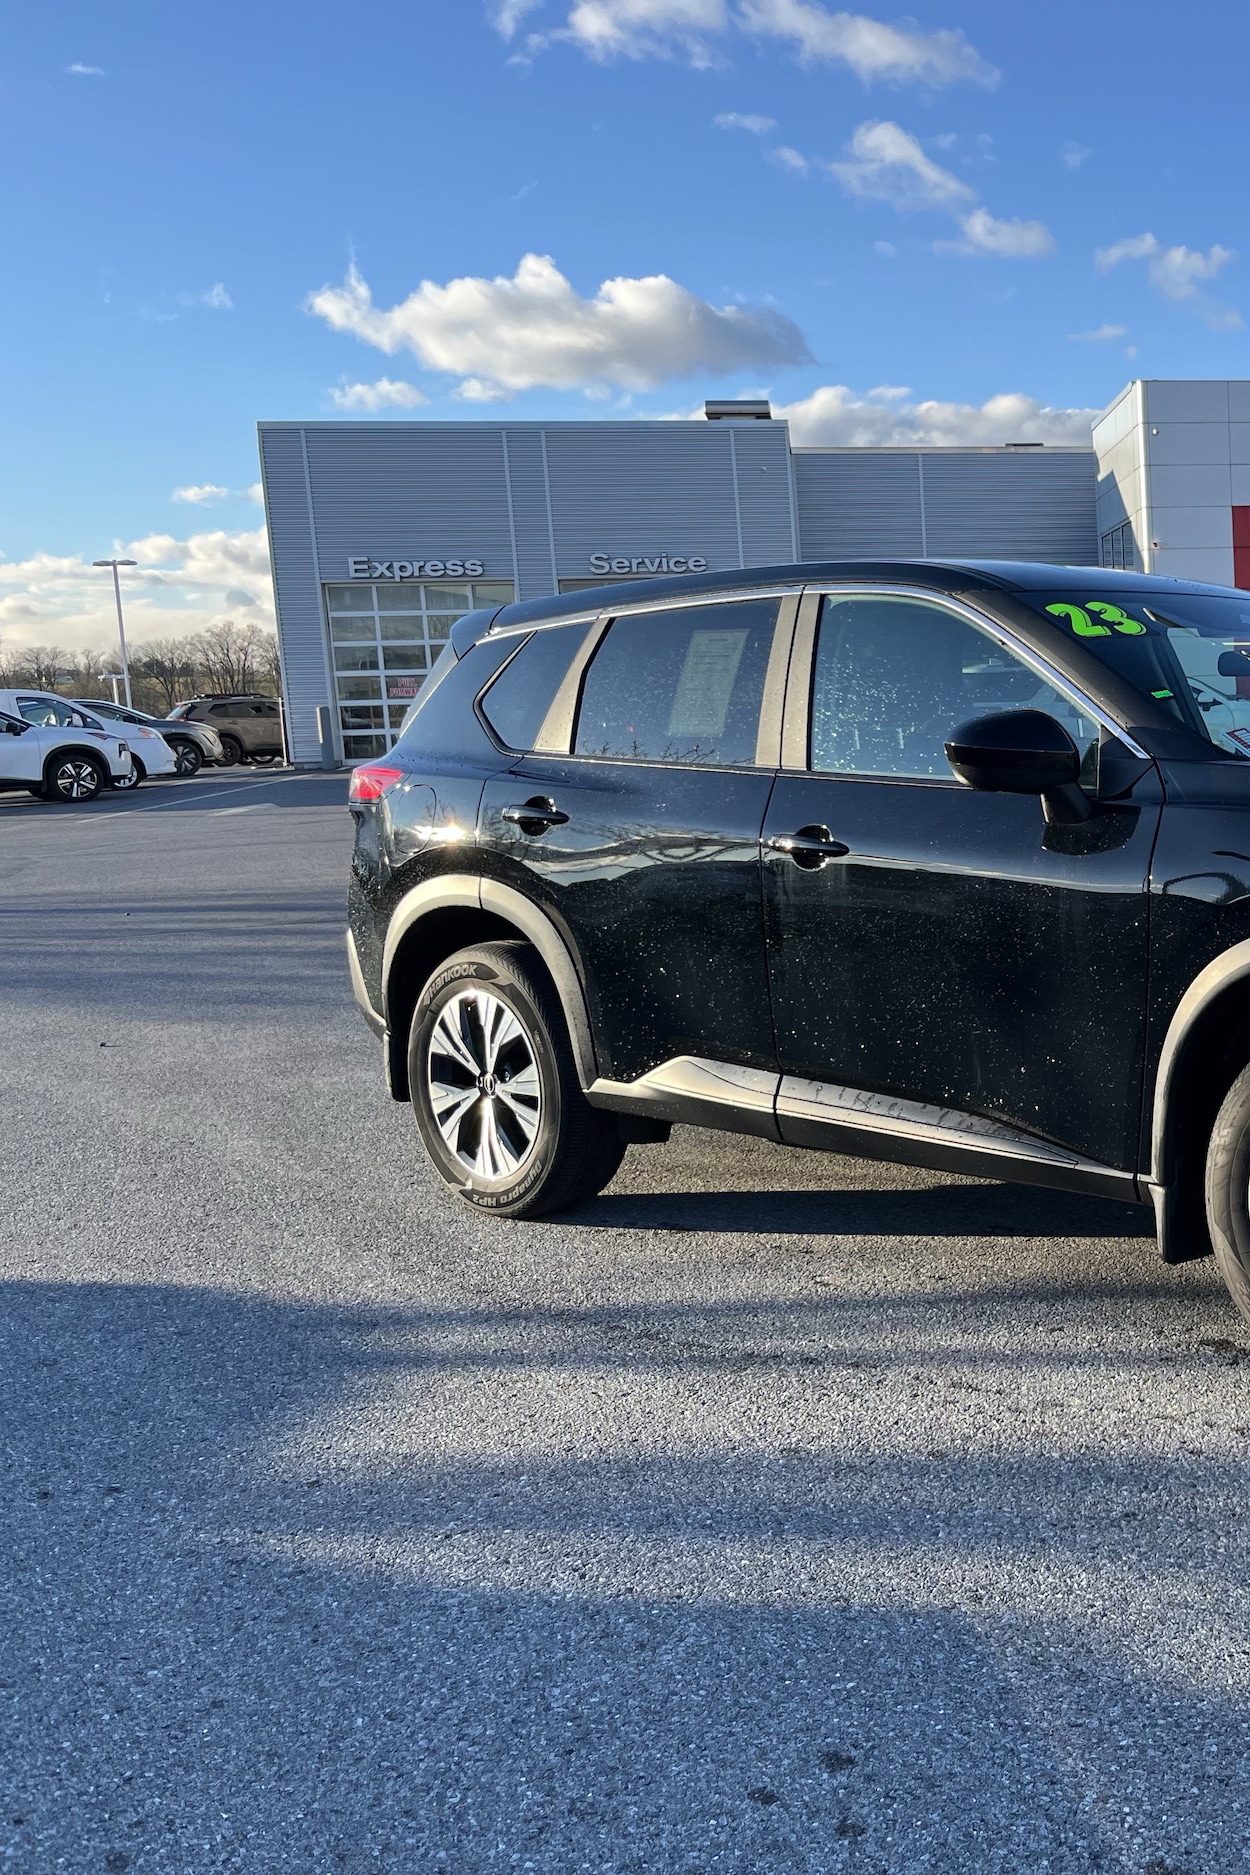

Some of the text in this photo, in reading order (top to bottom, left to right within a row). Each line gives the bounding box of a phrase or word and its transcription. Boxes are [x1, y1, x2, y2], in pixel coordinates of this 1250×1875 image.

[347, 553, 708, 582] Express Service
[1044, 601, 1147, 637] 23
[472, 1159, 543, 1206] Dynapro HP2
